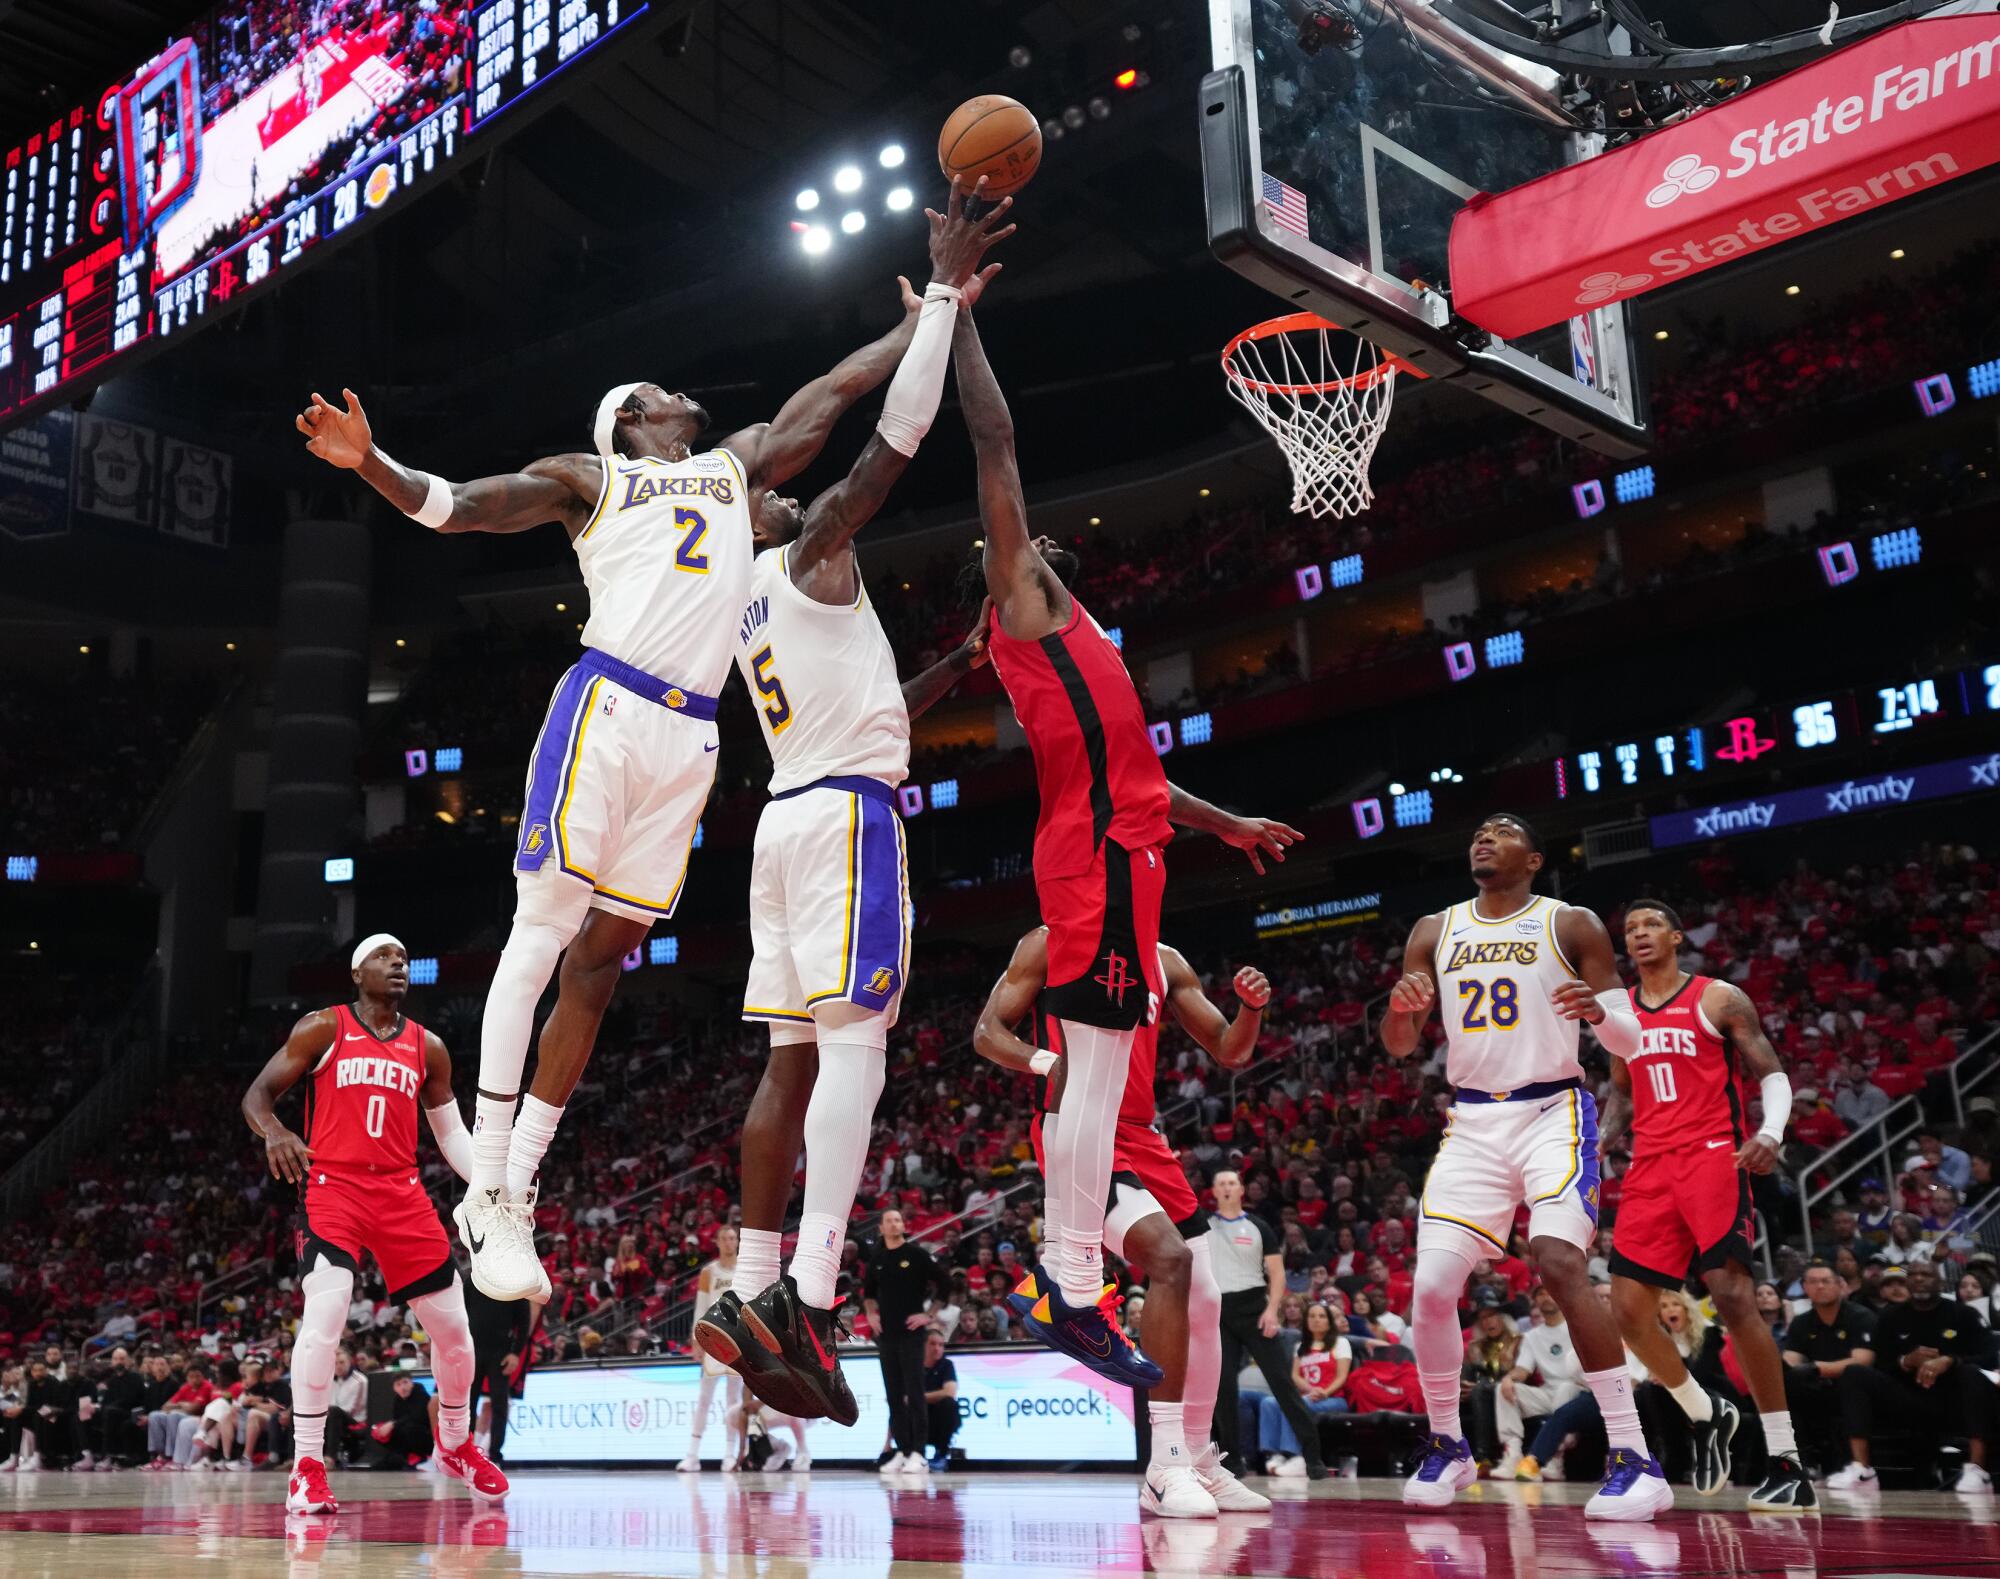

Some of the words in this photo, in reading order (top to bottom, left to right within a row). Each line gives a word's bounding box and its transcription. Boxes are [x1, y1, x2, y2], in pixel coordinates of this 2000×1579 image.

[1727, 95, 1864, 179] State
[1649, 212, 1803, 277] State
[1796, 152, 1960, 223] Farm
[618, 473, 735, 512] LAKERS
[674, 506, 710, 575] 2
[751, 642, 793, 736] 5
[1878, 679, 1939, 723] 7:14
[1792, 701, 1838, 748] 35
[1621, 760, 1638, 784] 2
[1661, 752, 1674, 776] 1
[1694, 802, 1776, 838] xfinity
[1825, 775, 1916, 813] xfinity
[1256, 906, 1316, 929] MEMORIAL
[1317, 893, 1381, 918] HERMANN
[1444, 940, 1539, 975] LAKERS
[1457, 976, 1521, 1034] 28
[336, 1057, 419, 1100] ROCKETS
[1646, 1062, 1677, 1103] 10
[366, 1094, 386, 1139] 0
[1006, 1388, 1103, 1428] peacock
